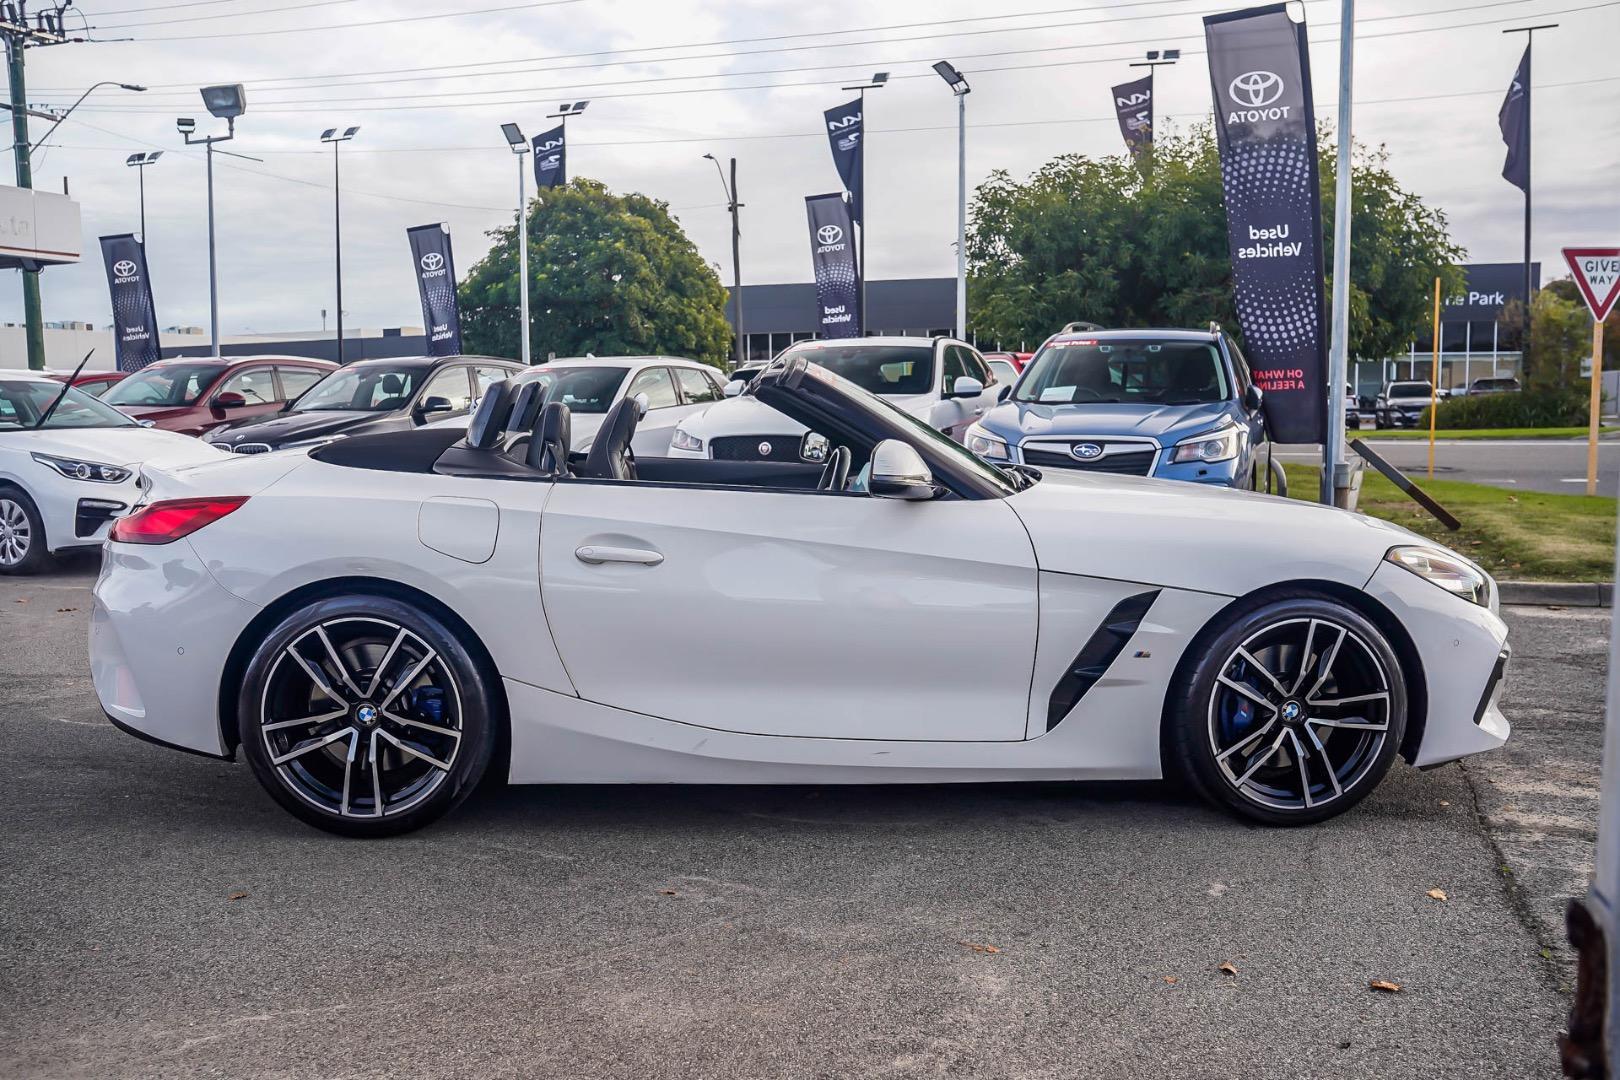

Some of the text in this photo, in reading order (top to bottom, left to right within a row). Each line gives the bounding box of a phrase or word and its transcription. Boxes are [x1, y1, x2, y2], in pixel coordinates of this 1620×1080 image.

[1585, 260, 1620, 272] GIVE
[1590, 275, 1613, 285] WAY
[1469, 291, 1504, 306] Park
